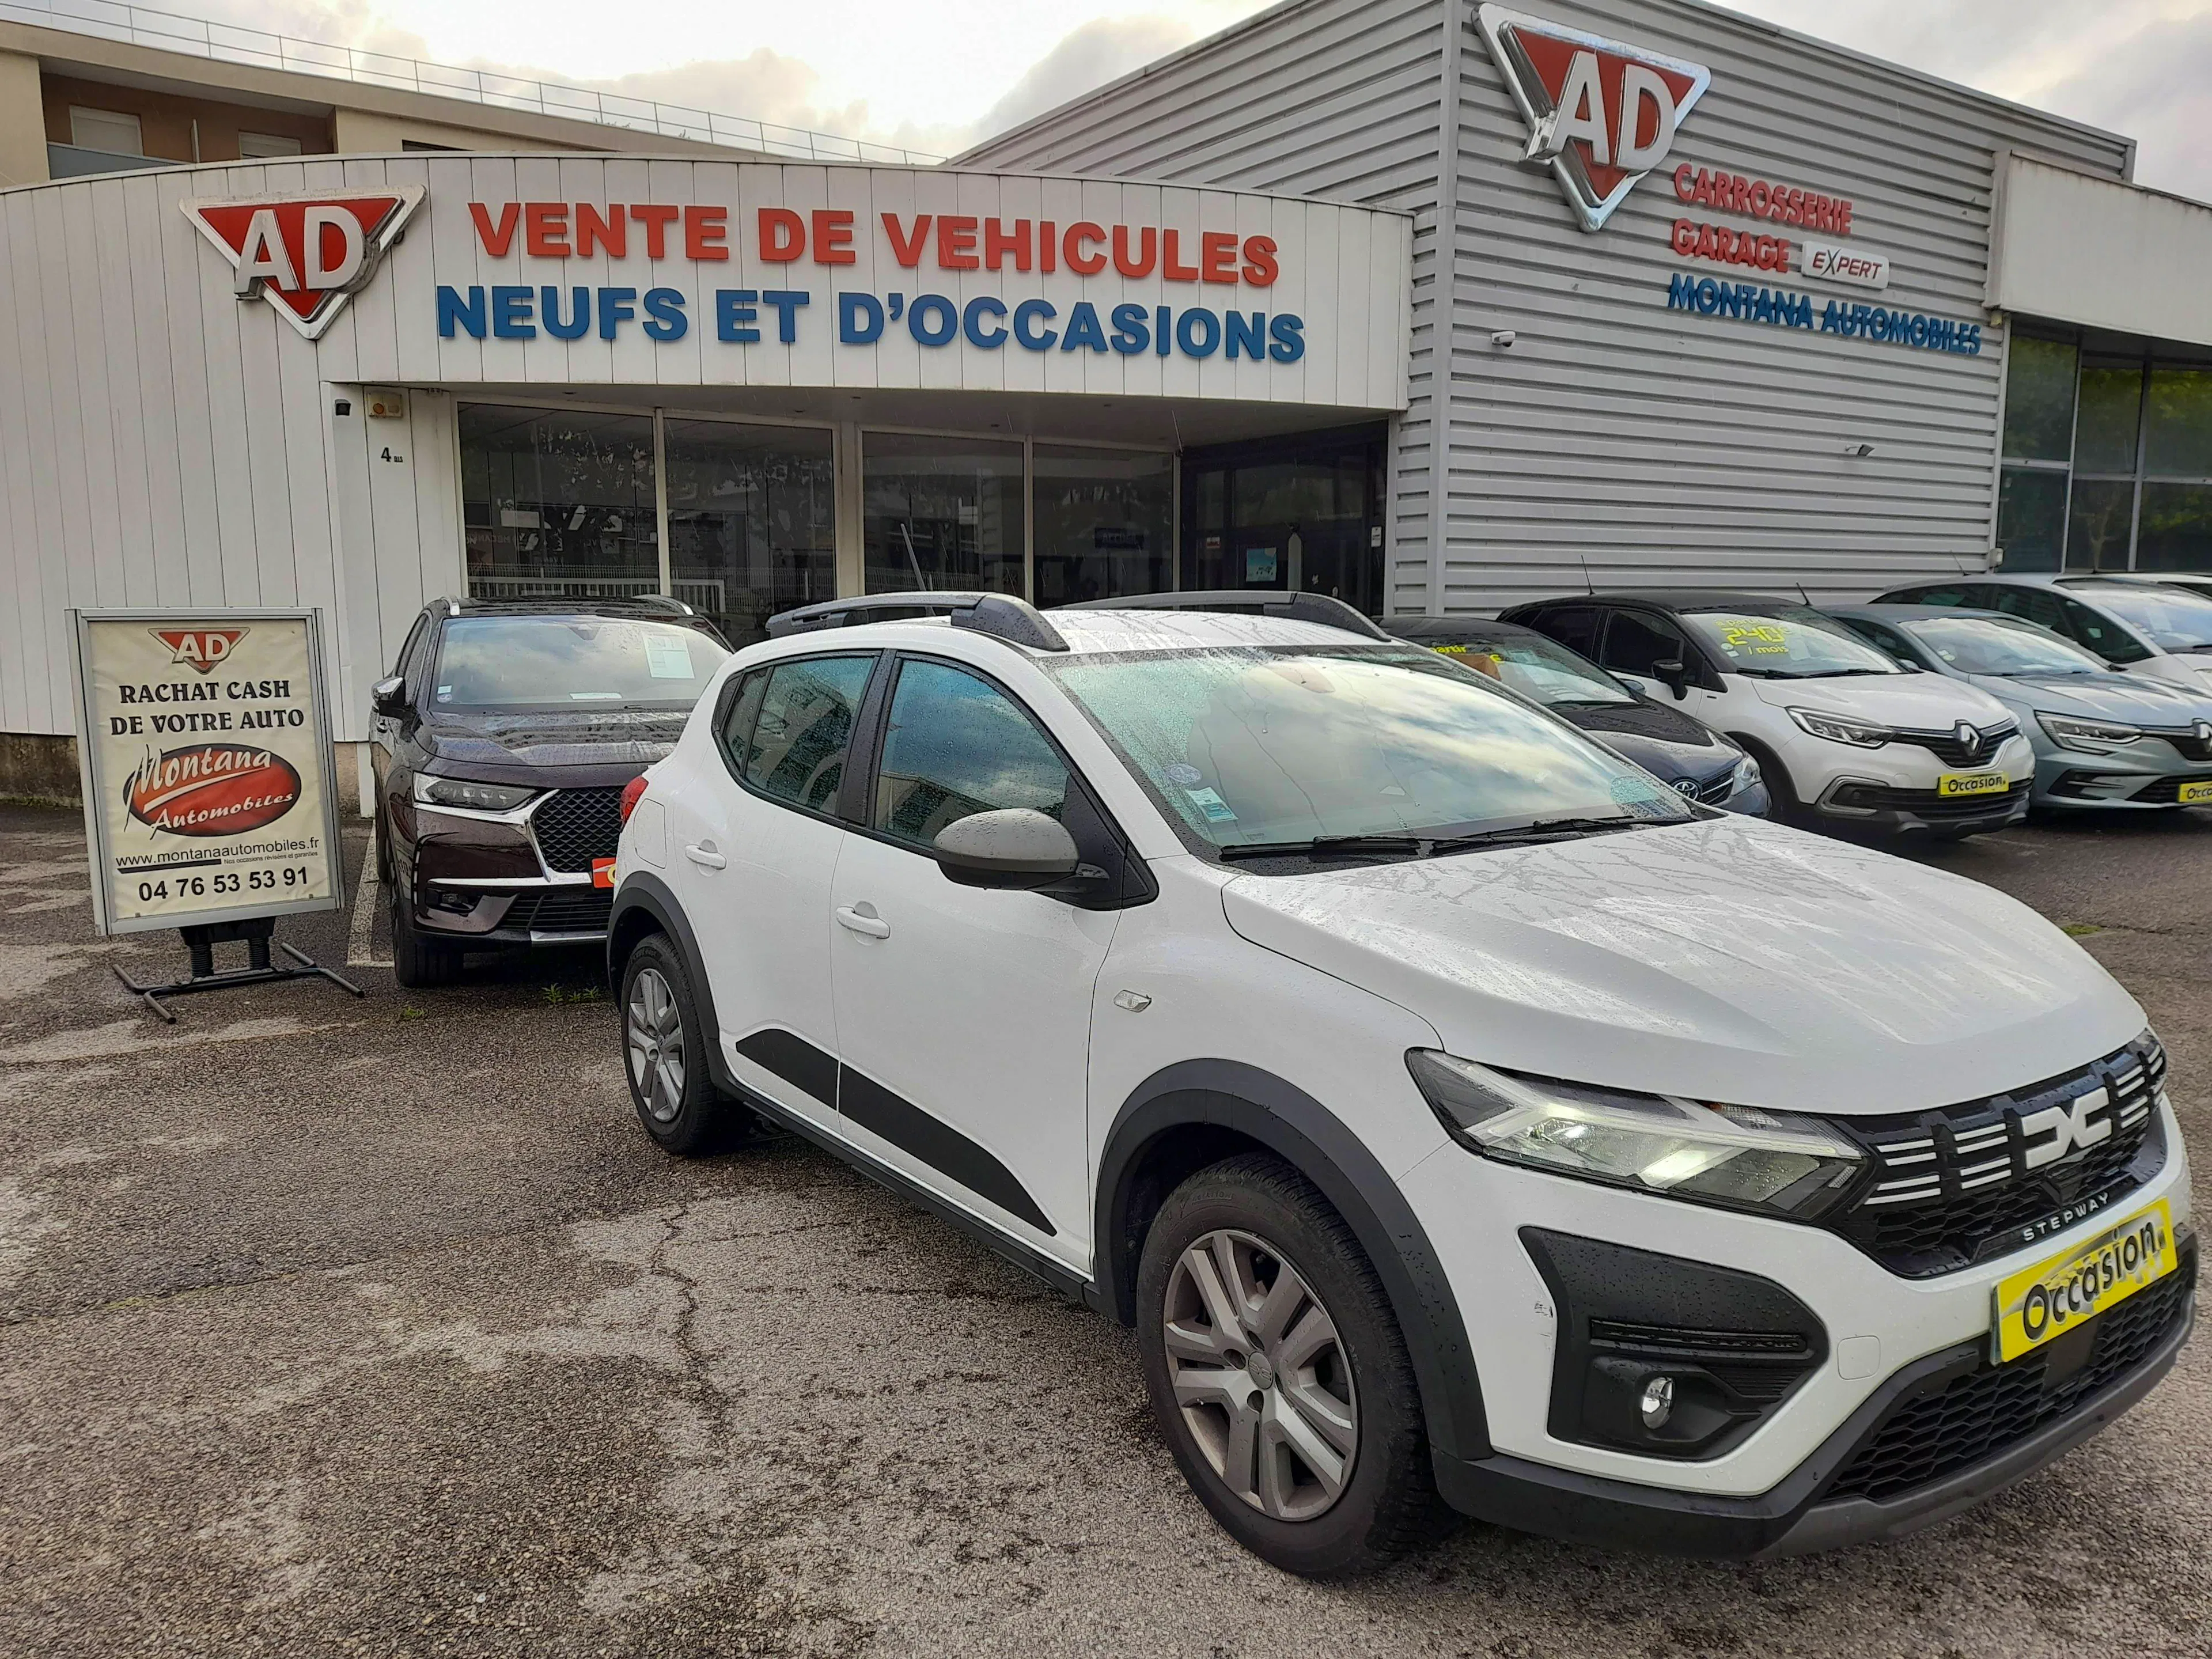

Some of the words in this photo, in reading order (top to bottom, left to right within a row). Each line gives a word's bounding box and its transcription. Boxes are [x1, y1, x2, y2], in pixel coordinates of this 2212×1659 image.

[1541, 50, 1677, 176] AD
[1673, 162, 1854, 236] CARROSSERIE
[234, 205, 370, 298] AD
[468, 202, 729, 260] VENTE
[758, 207, 856, 264] DE
[881, 213, 1279, 287] VEHICULES
[1672, 217, 1791, 273] GARAGE
[436, 285, 688, 342] NEUFS
[716, 289, 810, 343] ET
[838, 291, 1305, 362] D'OCCASIONS
[1668, 272, 1815, 329] MONTANA
[1820, 299, 1982, 355] AUTOMOBILES
[381, 447, 391, 462] 4
[173, 632, 230, 662] AD
[1756, 644, 1789, 654] mois
[119, 682, 219, 704] RACHAT
[226, 680, 291, 699] CASH
[110, 716, 143, 736] DE
[150, 712, 232, 733] VOTRE
[240, 709, 304, 729] AUTO
[124, 744, 272, 824] Montana
[1948, 776, 2003, 792] Occasion
[150, 793, 293, 840] Automobiles
[116, 836, 319, 866] www.montanaautomobiles.fr
[138, 880, 168, 902] 04
[176, 877, 205, 897] 76
[213, 874, 241, 893] 53
[249, 870, 275, 889] 53
[283, 866, 308, 886] 91
[2022, 1191, 2109, 1242] STEPWAY
[2022, 1221, 2157, 1342] Occasion
